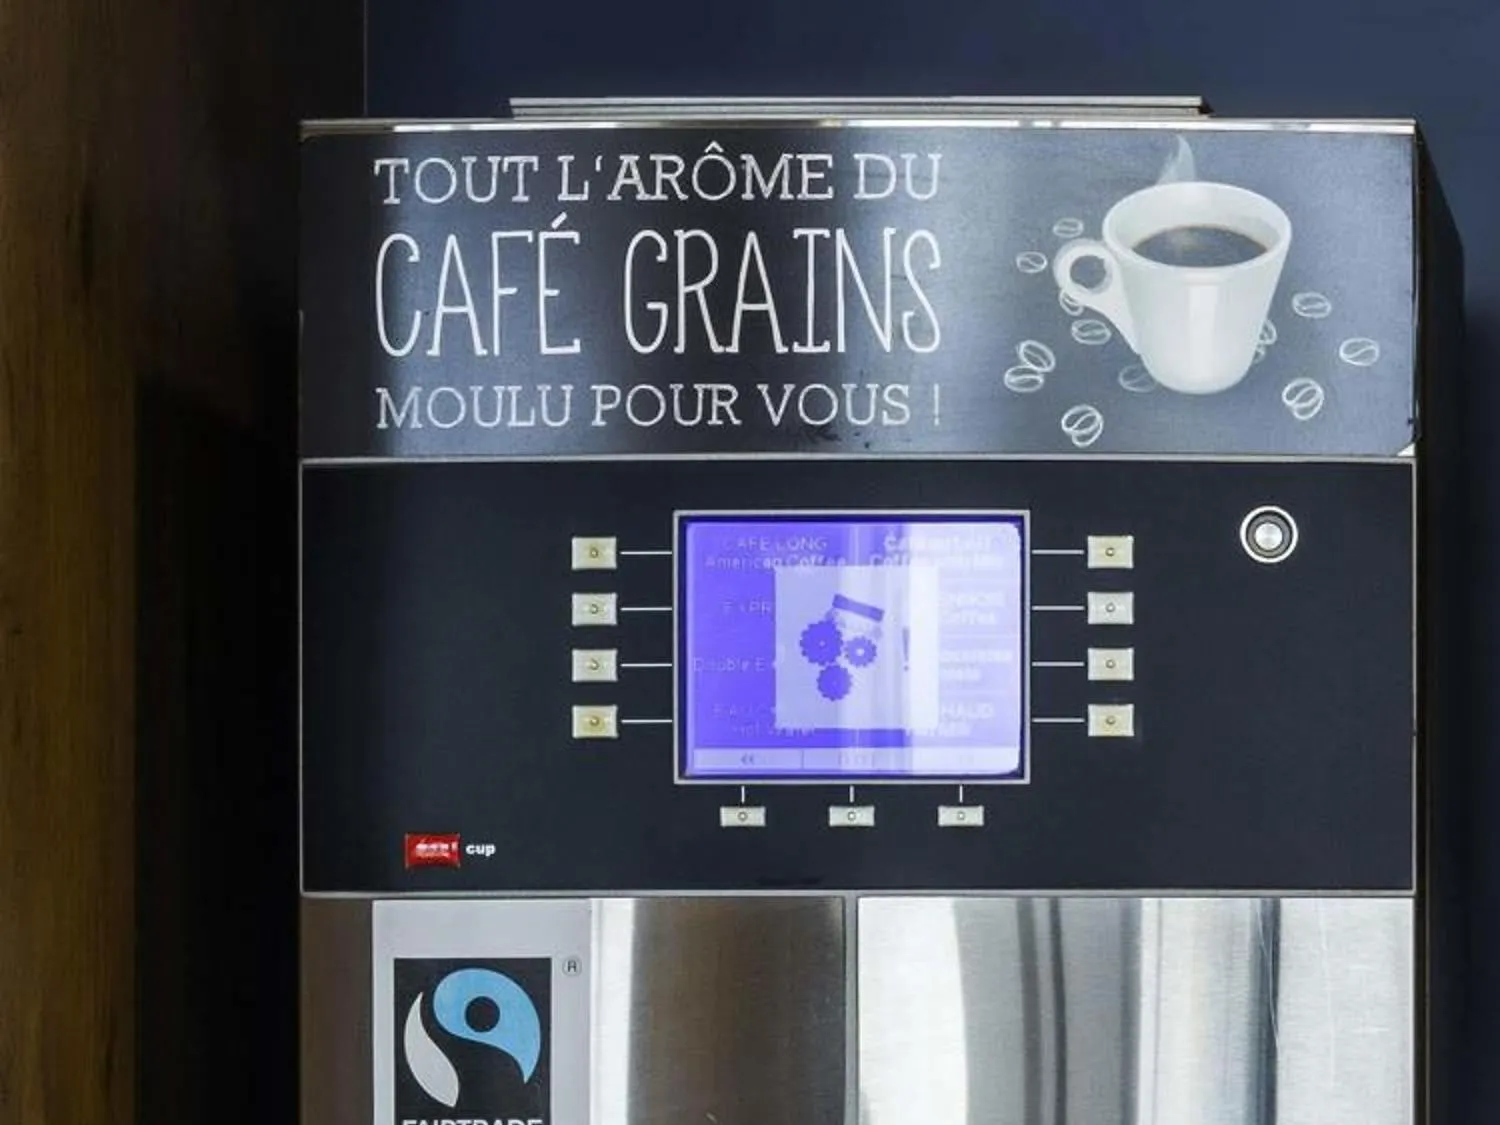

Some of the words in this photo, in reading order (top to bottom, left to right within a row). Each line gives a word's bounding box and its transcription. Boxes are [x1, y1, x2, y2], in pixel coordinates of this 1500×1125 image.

[374, 155, 539, 204] TOUT
[558, 141, 833, 203] L'ARÔME
[853, 153, 942, 200] DU
[374, 211, 582, 356] CAFÉ
[623, 227, 941, 354] GRAINS
[374, 385, 573, 430] MOULU
[590, 383, 742, 428] POUR
[757, 382, 911, 427] VOUS
[465, 843, 496, 857] cup
